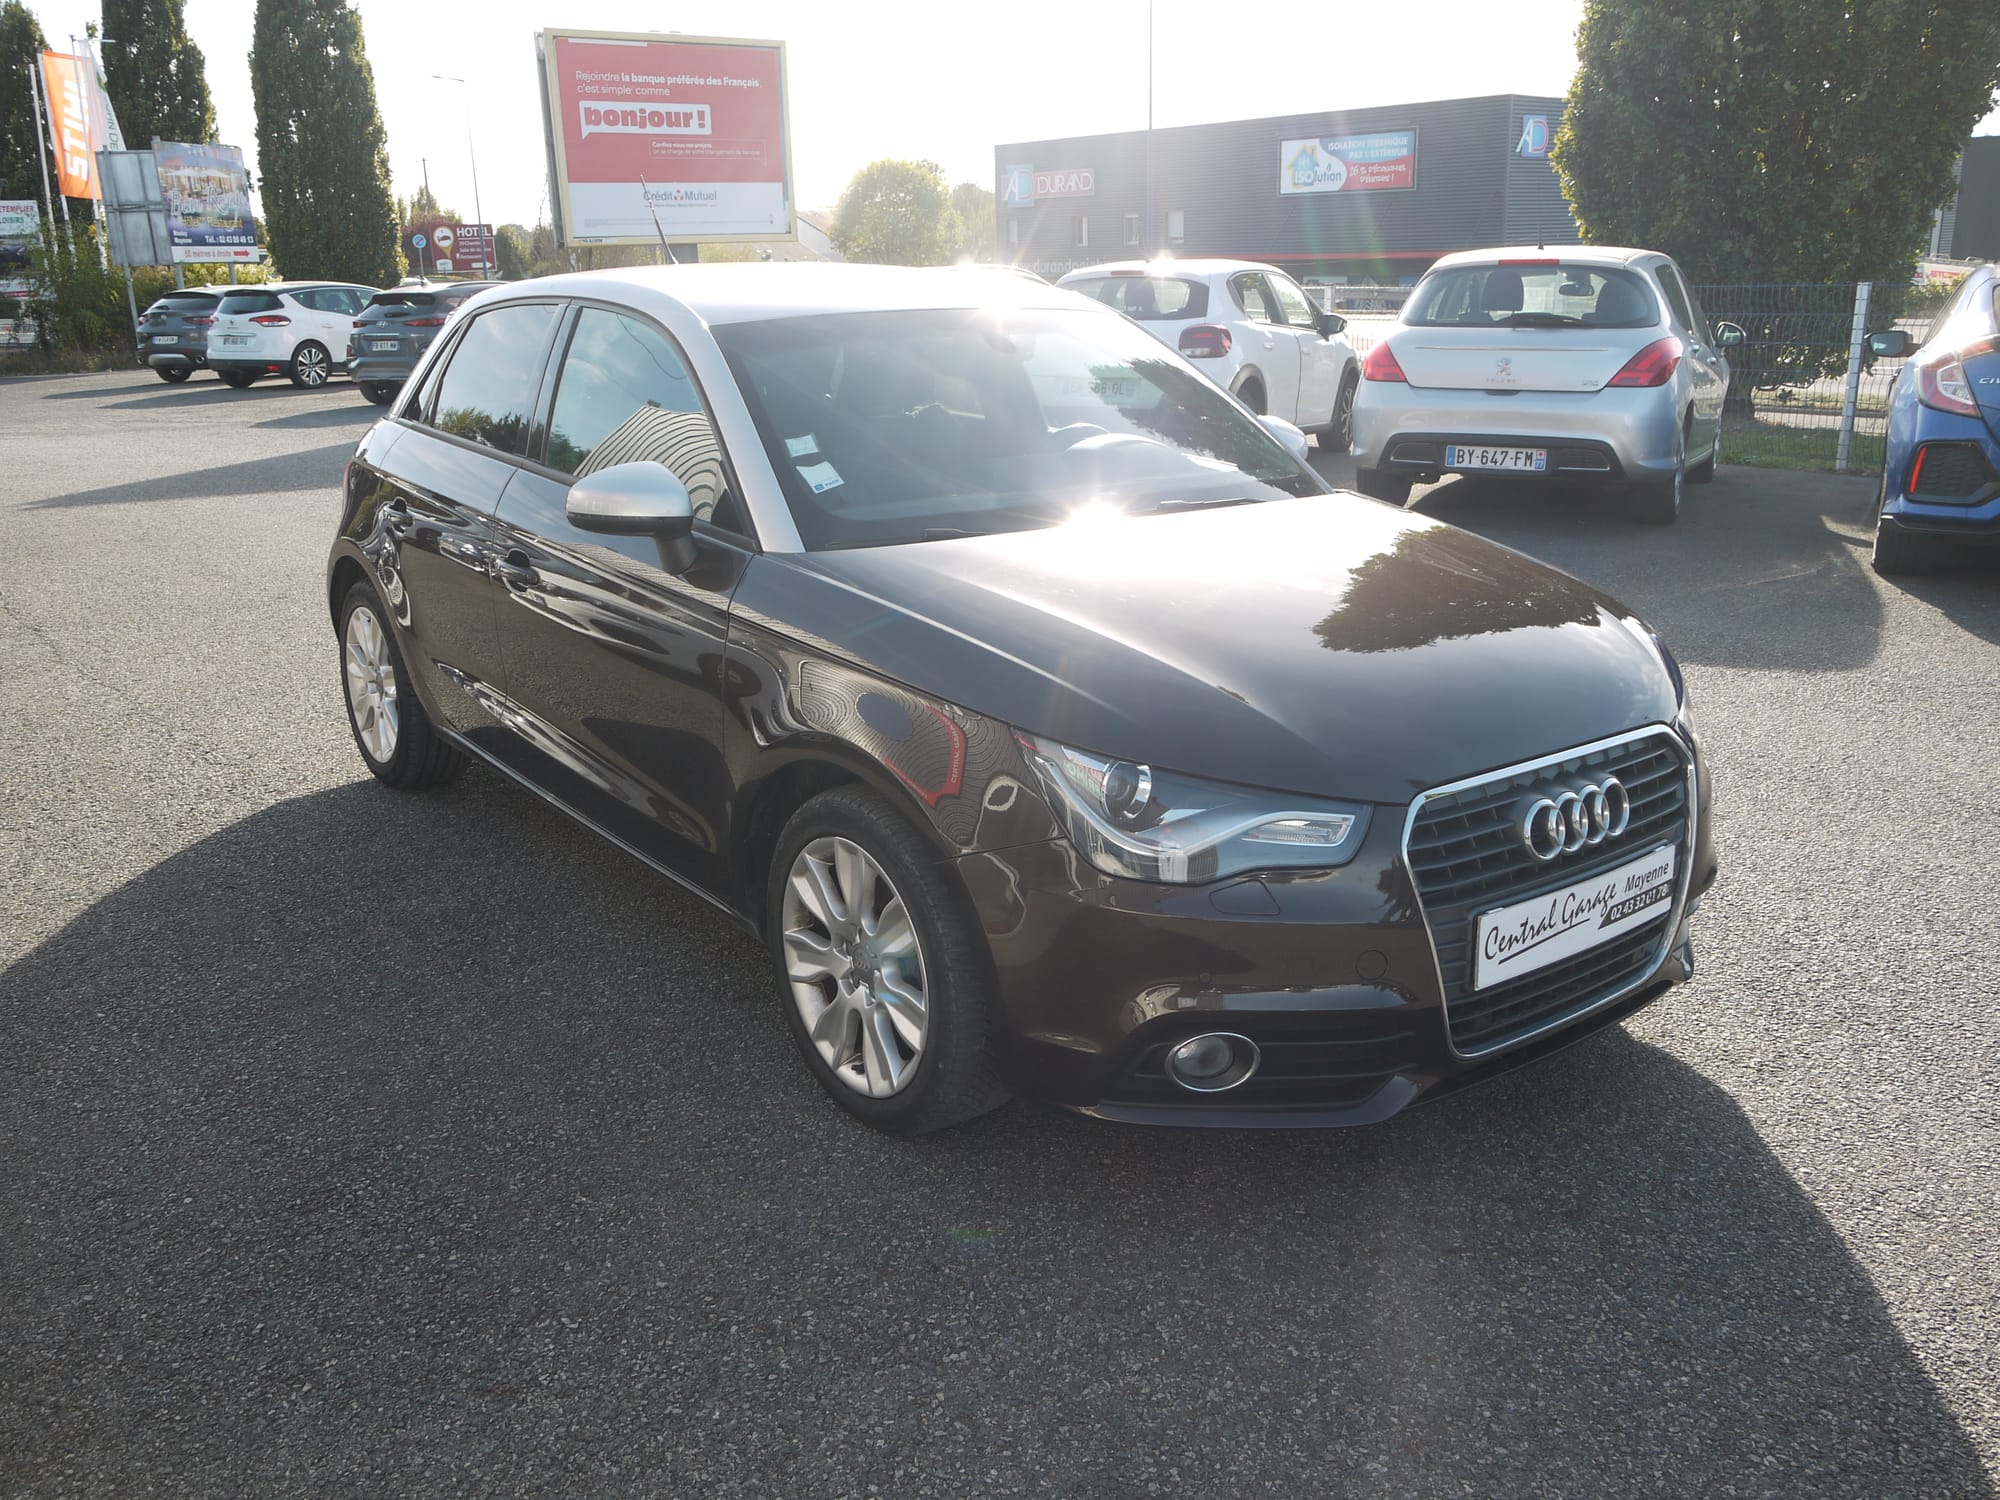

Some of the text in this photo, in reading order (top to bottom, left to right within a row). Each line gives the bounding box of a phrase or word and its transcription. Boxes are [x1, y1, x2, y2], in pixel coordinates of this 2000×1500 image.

[575, 70, 620, 83] Rejoindre
[621, 72, 630, 82] la
[631, 73, 666, 85] banque
[666, 75, 705, 87] préférée
[706, 76, 722, 86] des
[601, 84, 632, 97] simple
[635, 86, 671, 96] comme
[583, 106, 706, 129] bonjour !
[1515, 118, 1549, 153] AD
[1328, 141, 1365, 151] ISOLATION
[1037, 172, 1094, 194] DURAND
[642, 190, 718, 202] Crédit Mutuel
[456, 226, 491, 237] HOTEL
[1456, 448, 1533, 467] BY-647-FM
[1624, 863, 1669, 893] Mayenne
[1484, 883, 1617, 960] Central Garage
